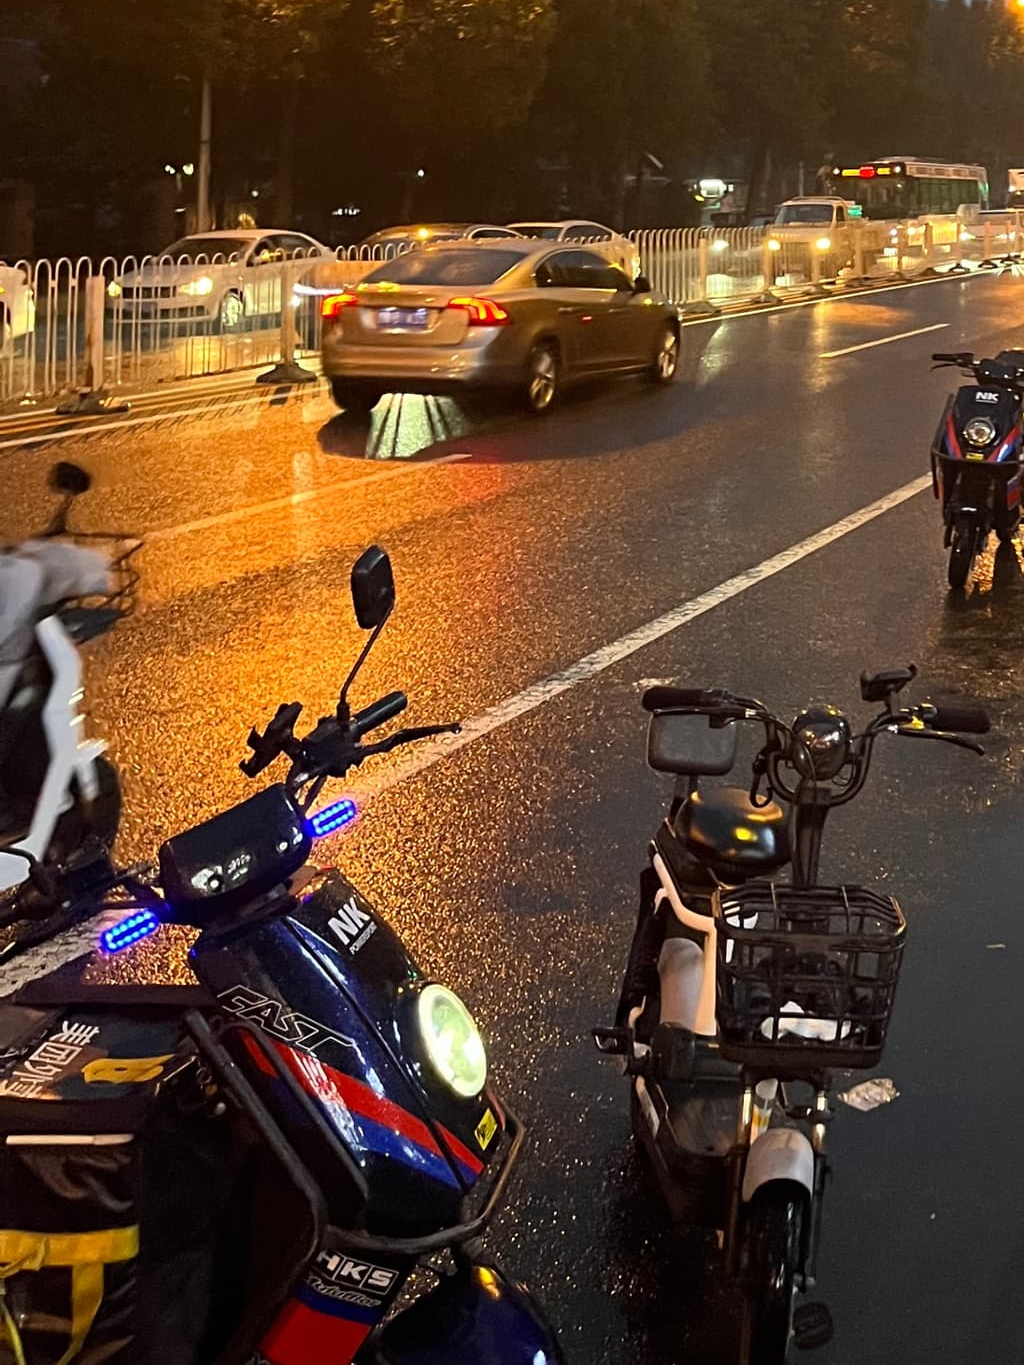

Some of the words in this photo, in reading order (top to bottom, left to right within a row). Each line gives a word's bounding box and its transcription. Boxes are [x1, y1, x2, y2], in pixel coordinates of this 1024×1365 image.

[976, 392, 999, 402] NK
[328, 897, 371, 945] NK
[217, 984, 355, 1051] FAST
[317, 1250, 393, 1287] HKS
